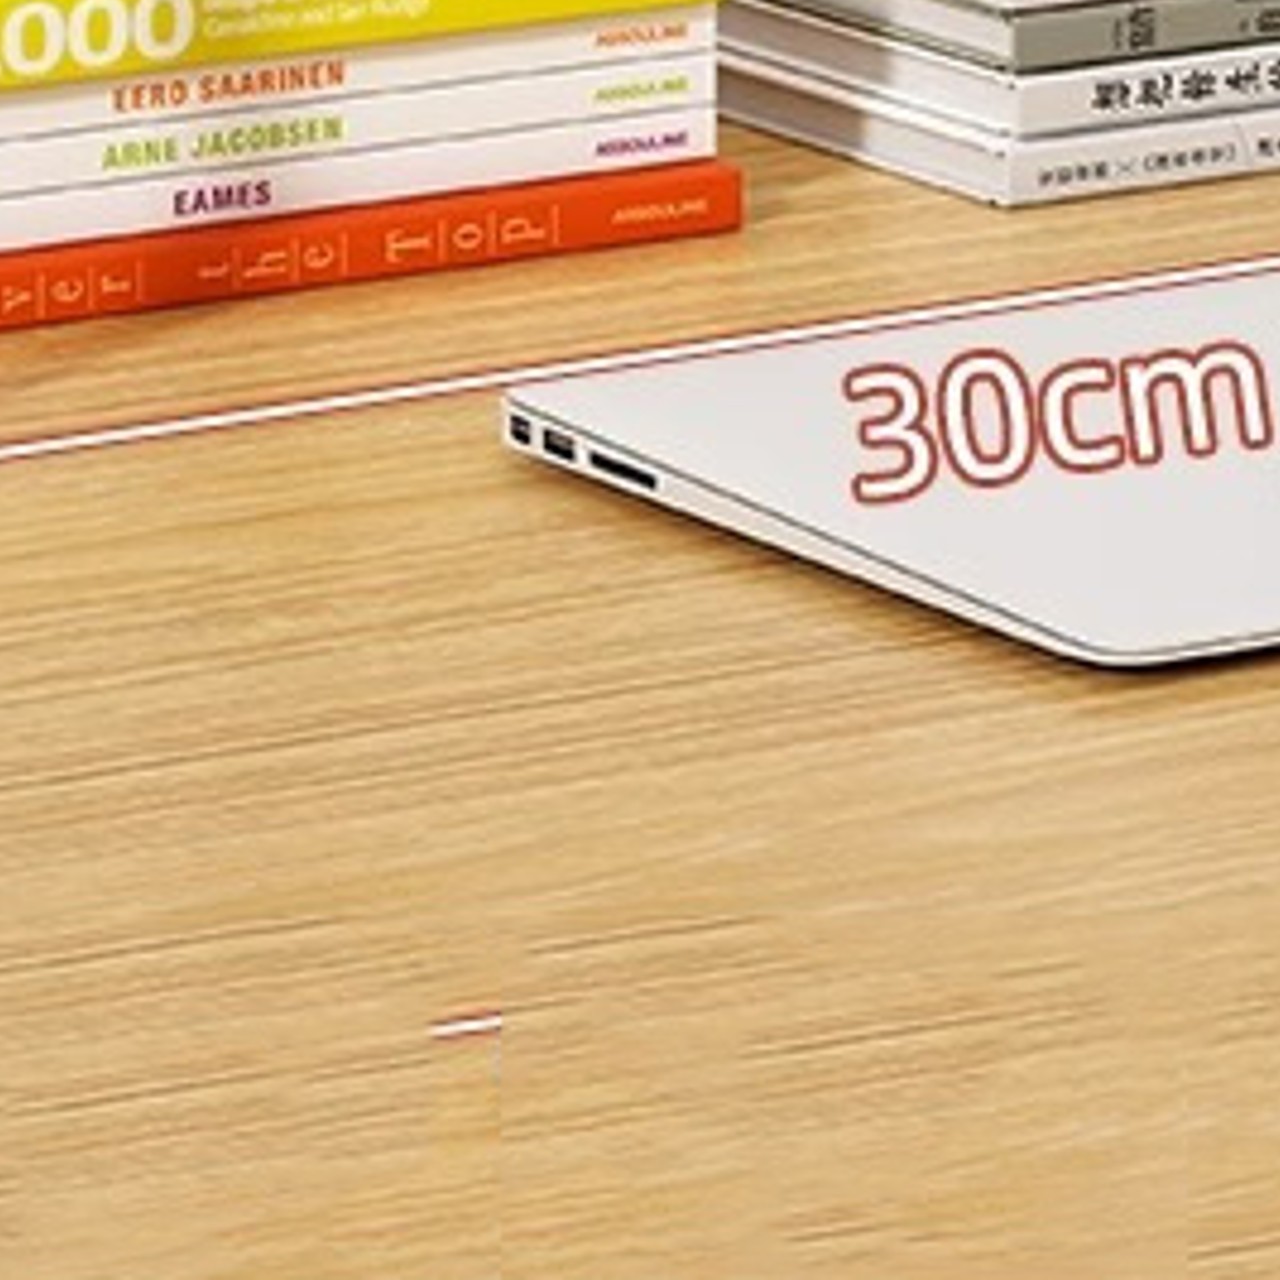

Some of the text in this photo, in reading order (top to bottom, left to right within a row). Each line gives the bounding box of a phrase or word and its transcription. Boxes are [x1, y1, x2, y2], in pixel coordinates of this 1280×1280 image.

[111, 60, 346, 113] EERO SAARINEN
[101, 116, 345, 172] ARNE JACOBSEN
[172, 179, 273, 218] EAMES
